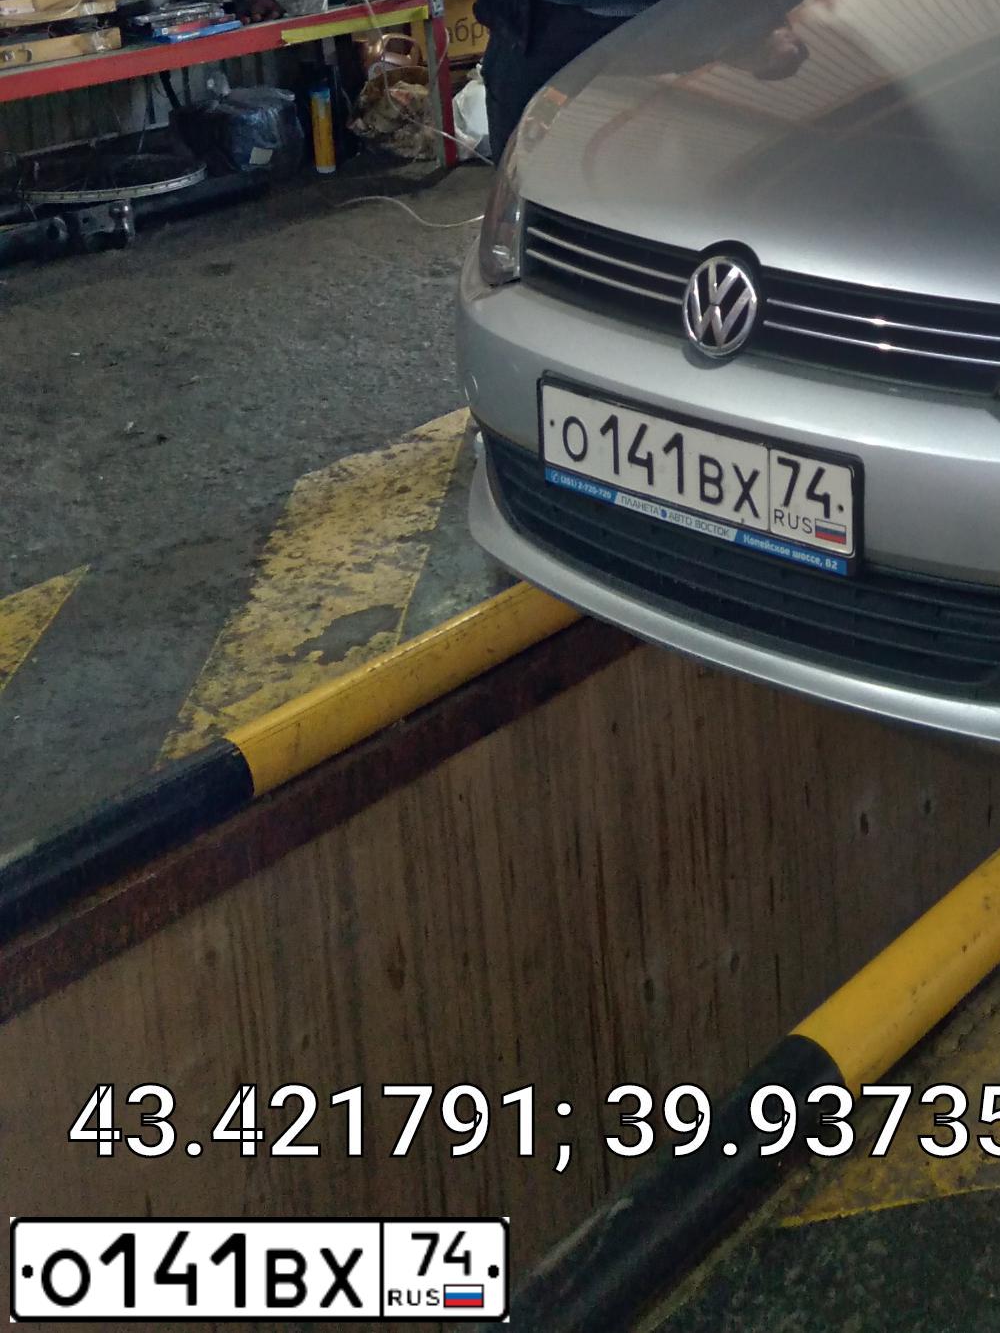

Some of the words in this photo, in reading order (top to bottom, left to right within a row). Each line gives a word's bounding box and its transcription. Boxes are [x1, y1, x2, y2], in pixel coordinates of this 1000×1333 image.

[562, 413, 761, 519] О141ВХ
[777, 456, 831, 518] 74
[621, 495, 659, 515] ПЛАНЕТА
[668, 511, 692, 526] АВТО
[694, 519, 730, 538] ВОСТОК
[773, 508, 813, 534] RUS
